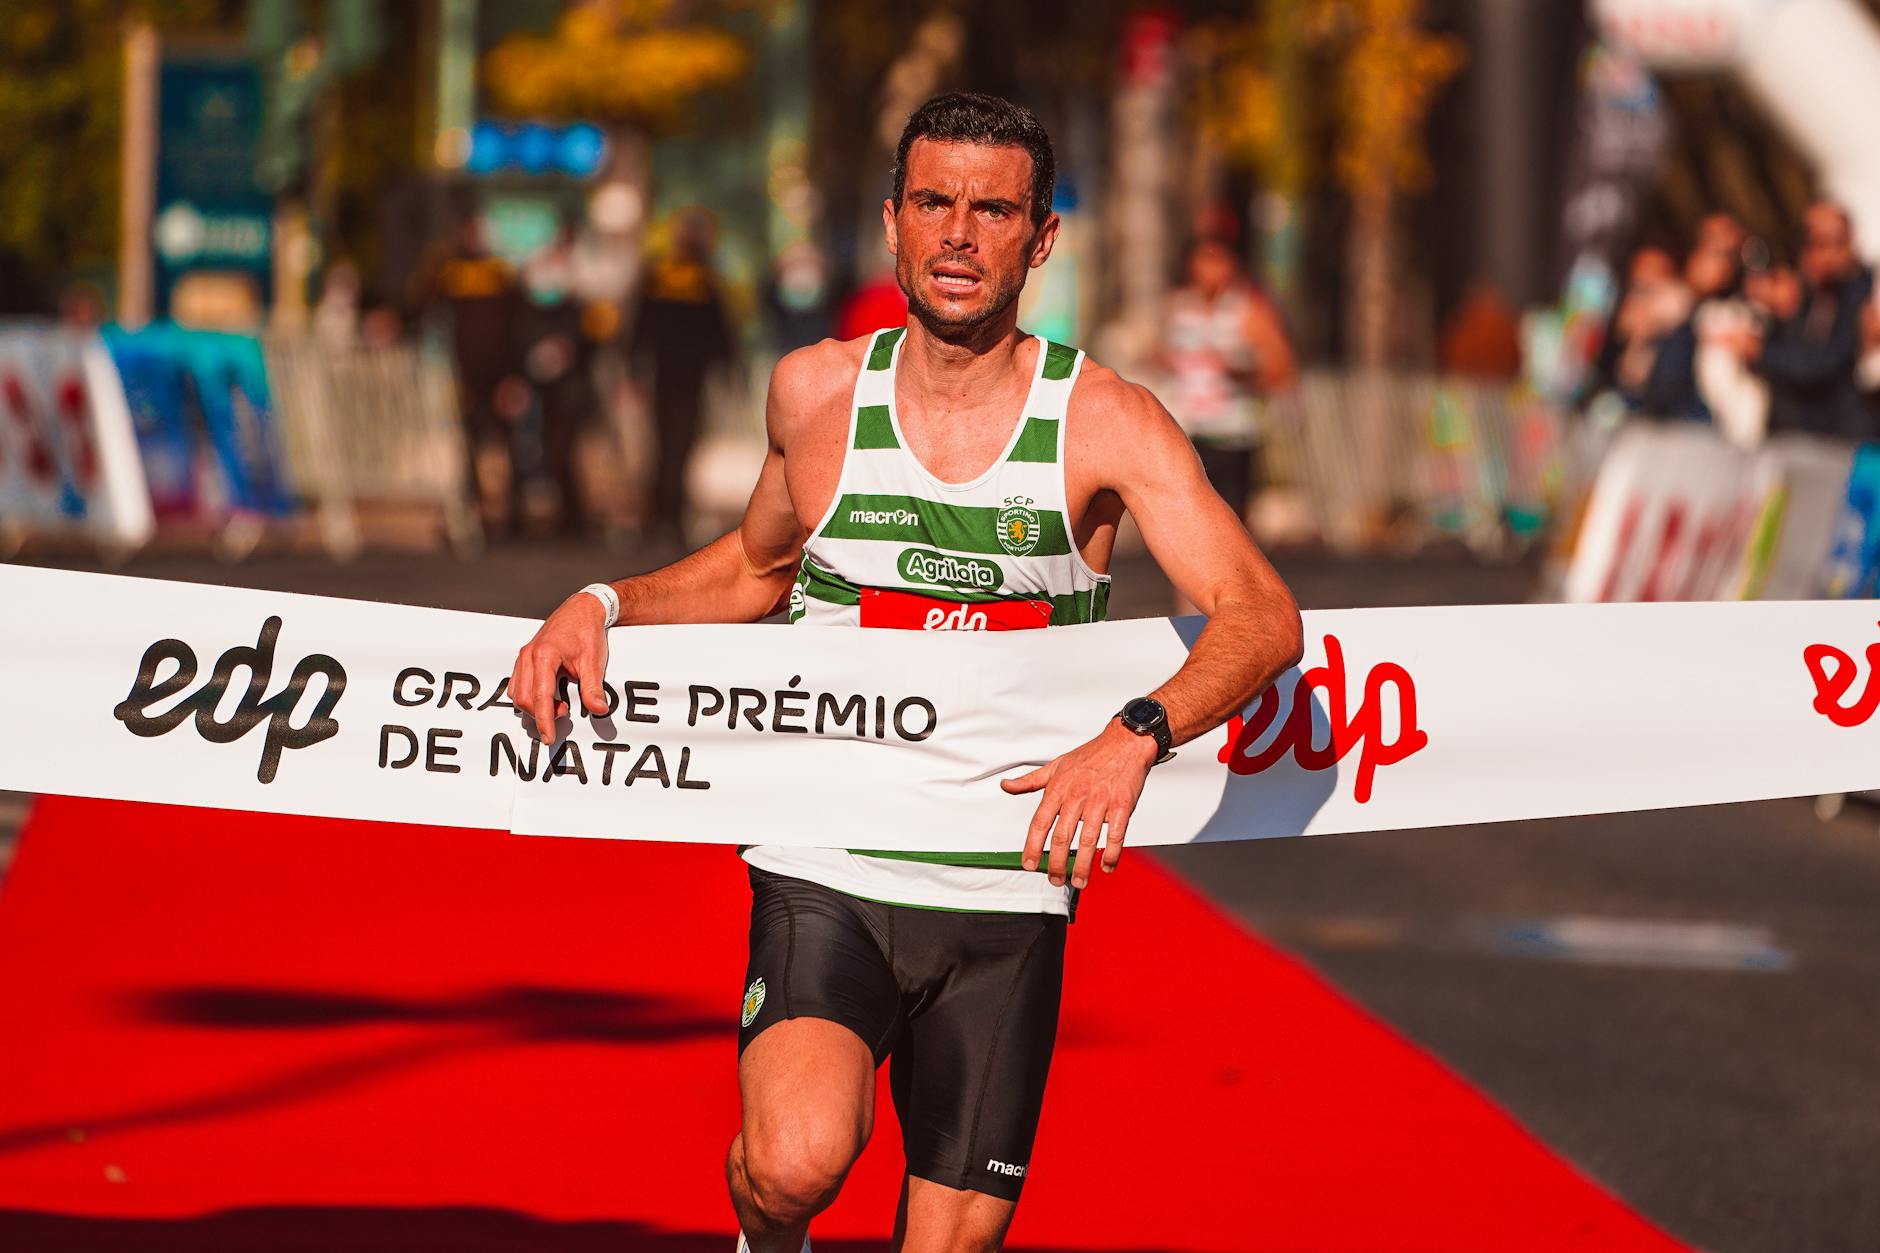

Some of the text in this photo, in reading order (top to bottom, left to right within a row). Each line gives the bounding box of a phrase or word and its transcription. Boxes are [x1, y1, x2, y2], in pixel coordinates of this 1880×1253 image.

[850, 509, 919, 526] macron
[1001, 509, 1036, 523] SPORTING
[1003, 495, 1034, 507] SCP
[1003, 541, 1034, 552] PORTUGAL
[906, 552, 994, 587] Agriloja
[113, 615, 347, 785] edp
[687, 674, 937, 739] PRÉMIO
[1217, 634, 1428, 804] edp
[378, 724, 711, 790] DE NATAL
